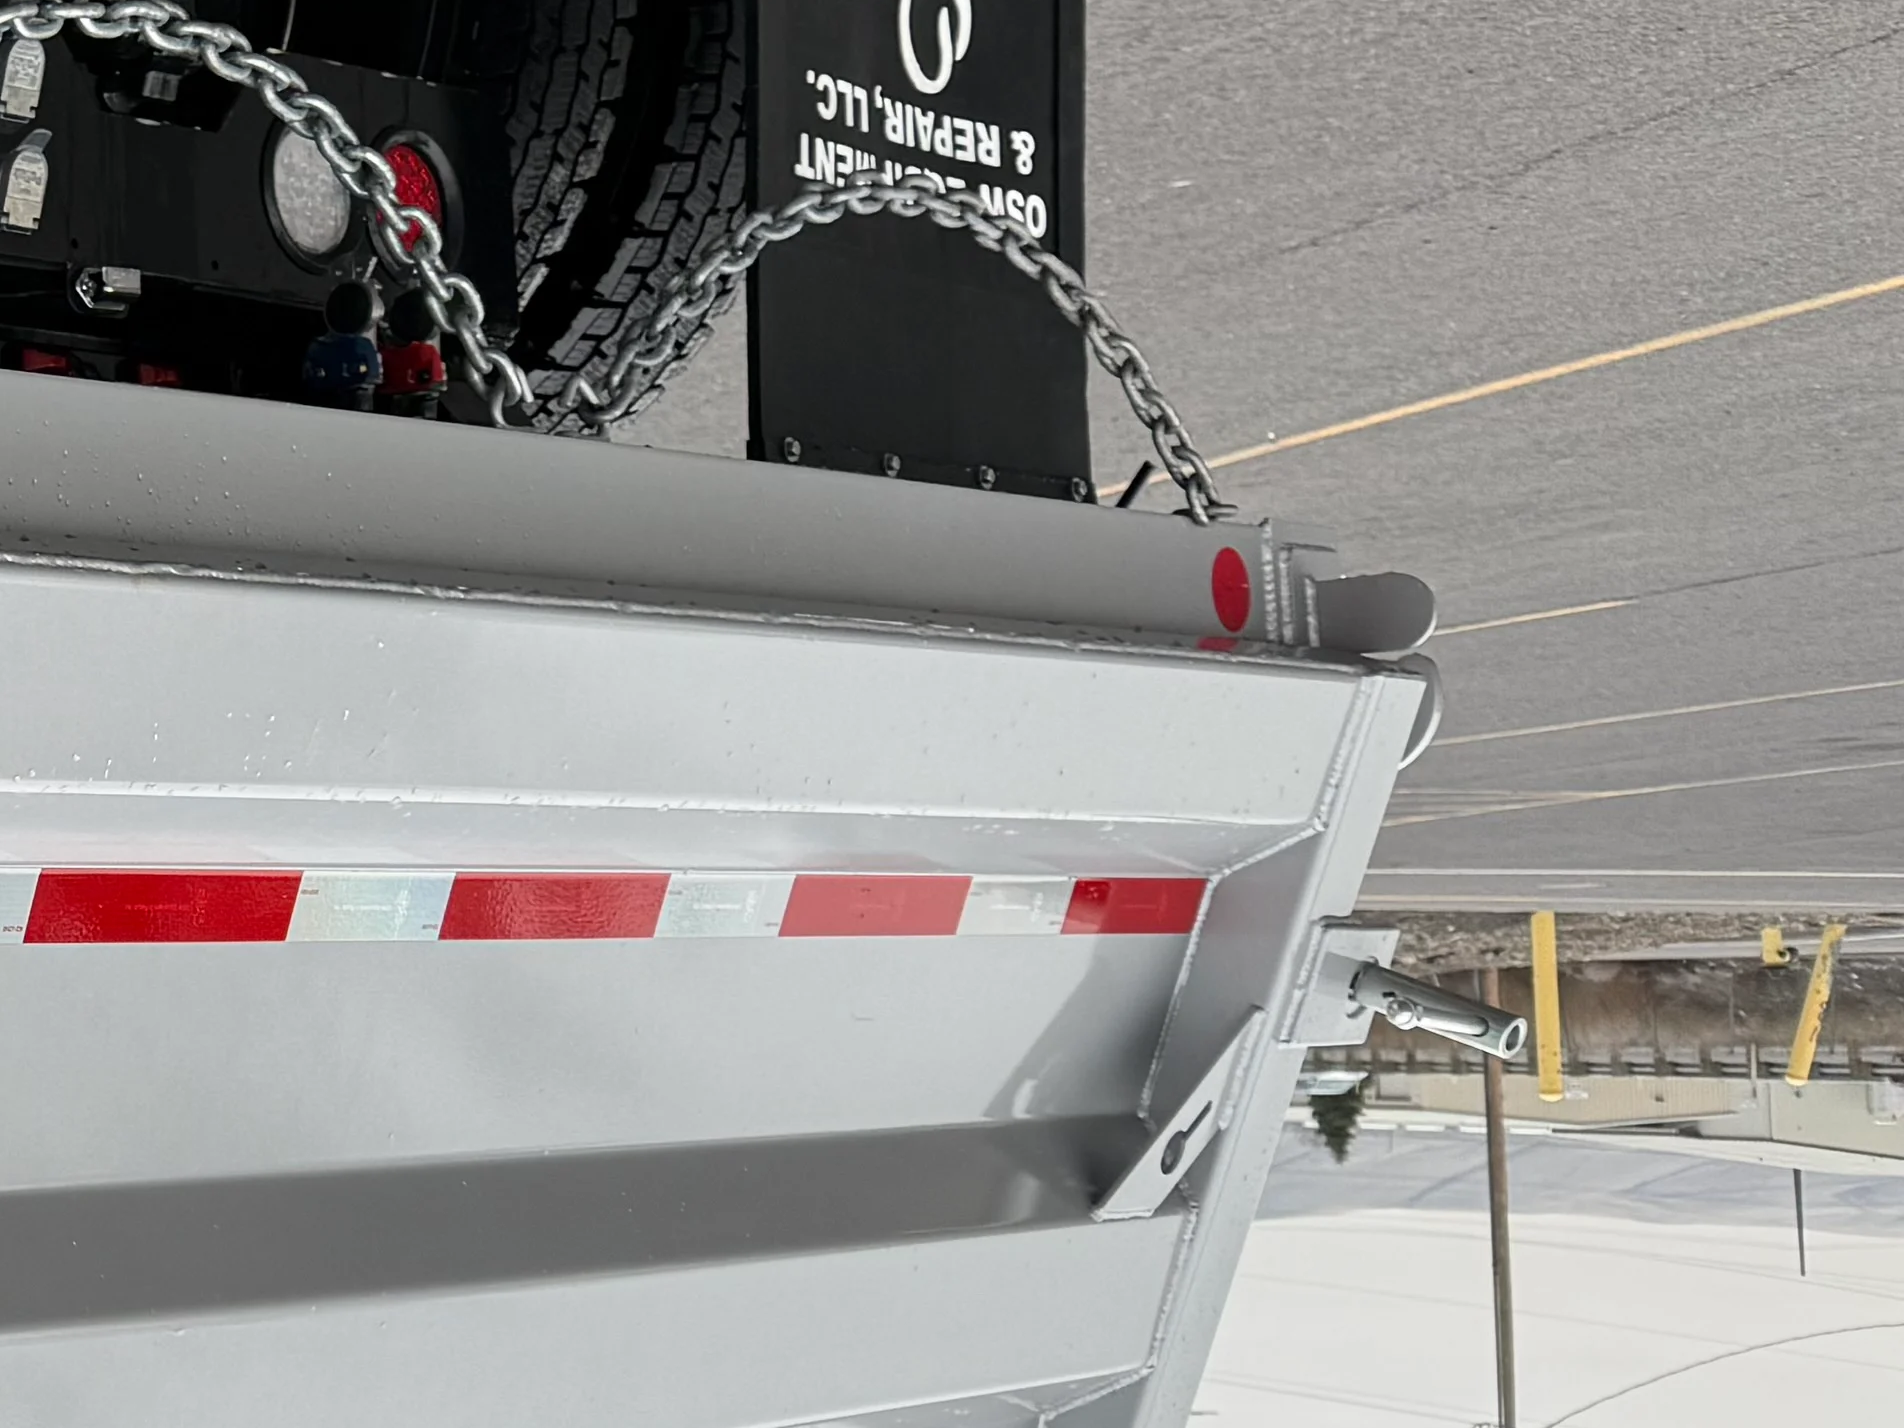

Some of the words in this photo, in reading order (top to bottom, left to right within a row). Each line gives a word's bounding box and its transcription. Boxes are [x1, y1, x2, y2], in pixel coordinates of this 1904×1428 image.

[807, 70, 870, 133] LLC.
[875, 86, 1001, 168] REPAIR,
[1011, 131, 1036, 175] &
